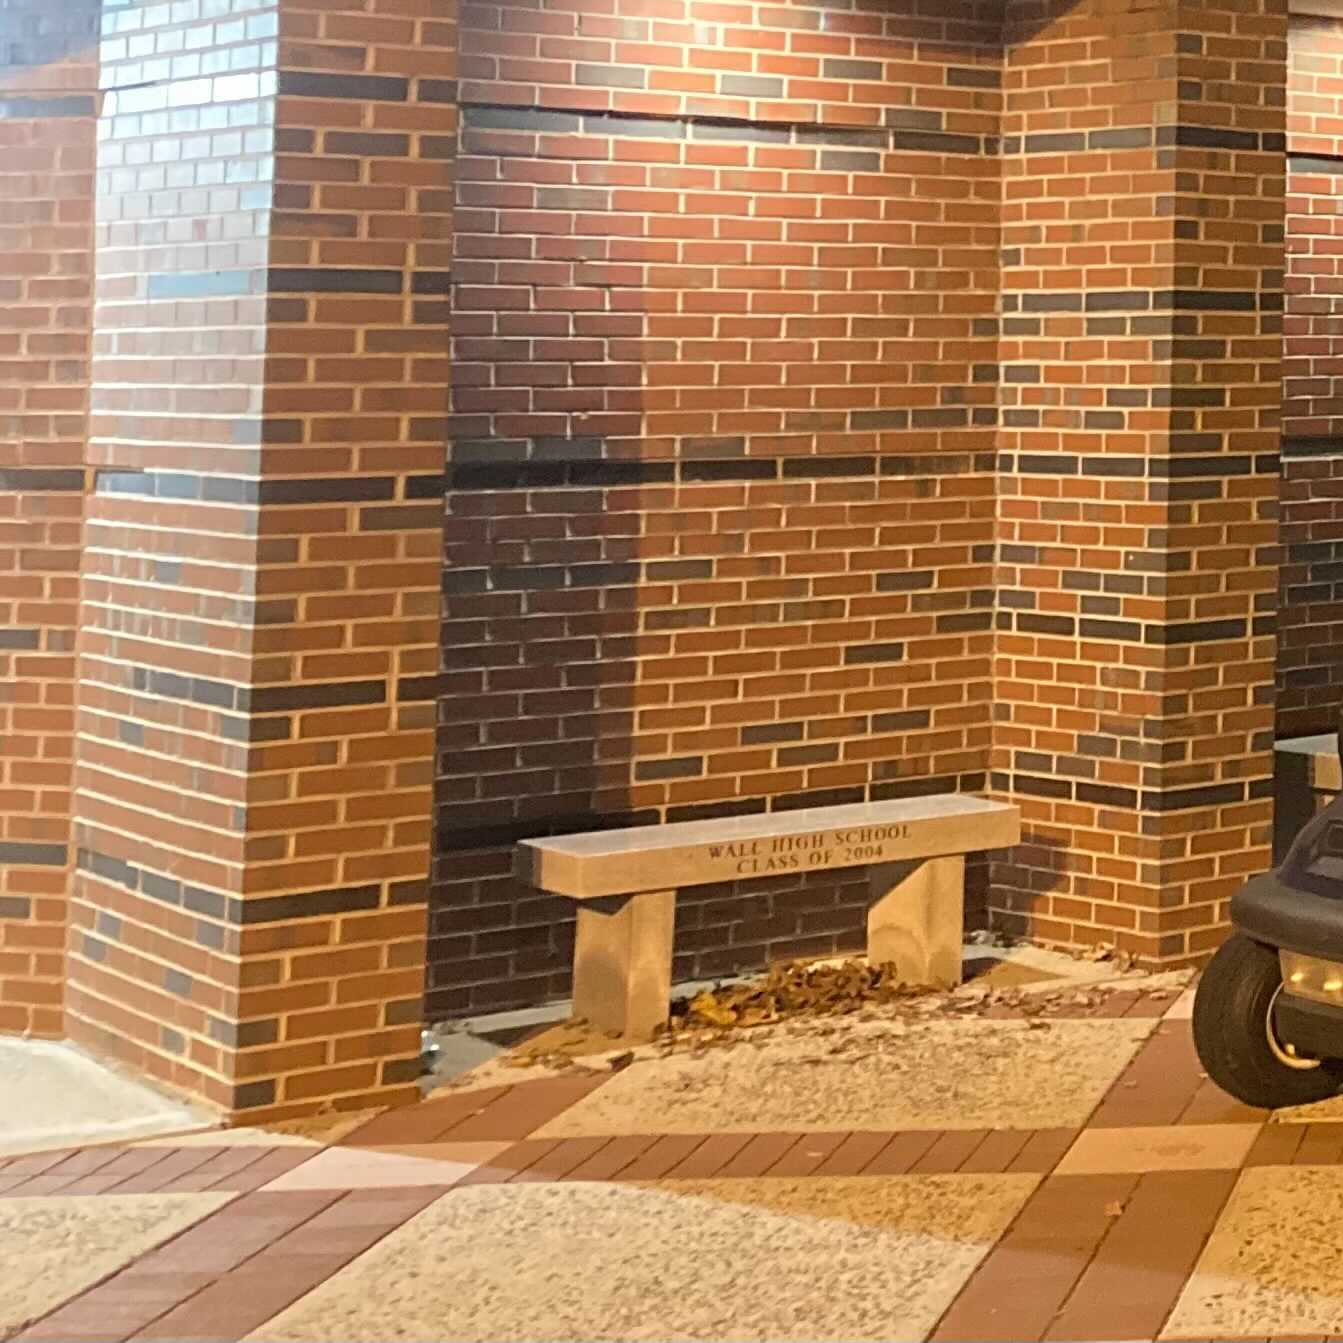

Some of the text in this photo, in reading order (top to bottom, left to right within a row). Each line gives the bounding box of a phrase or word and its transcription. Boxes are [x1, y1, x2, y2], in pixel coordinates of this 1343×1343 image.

[708, 824, 912, 859] WALL HIGH SCHOOL
[736, 856, 800, 874] CLASS
[808, 850, 834, 865] OF
